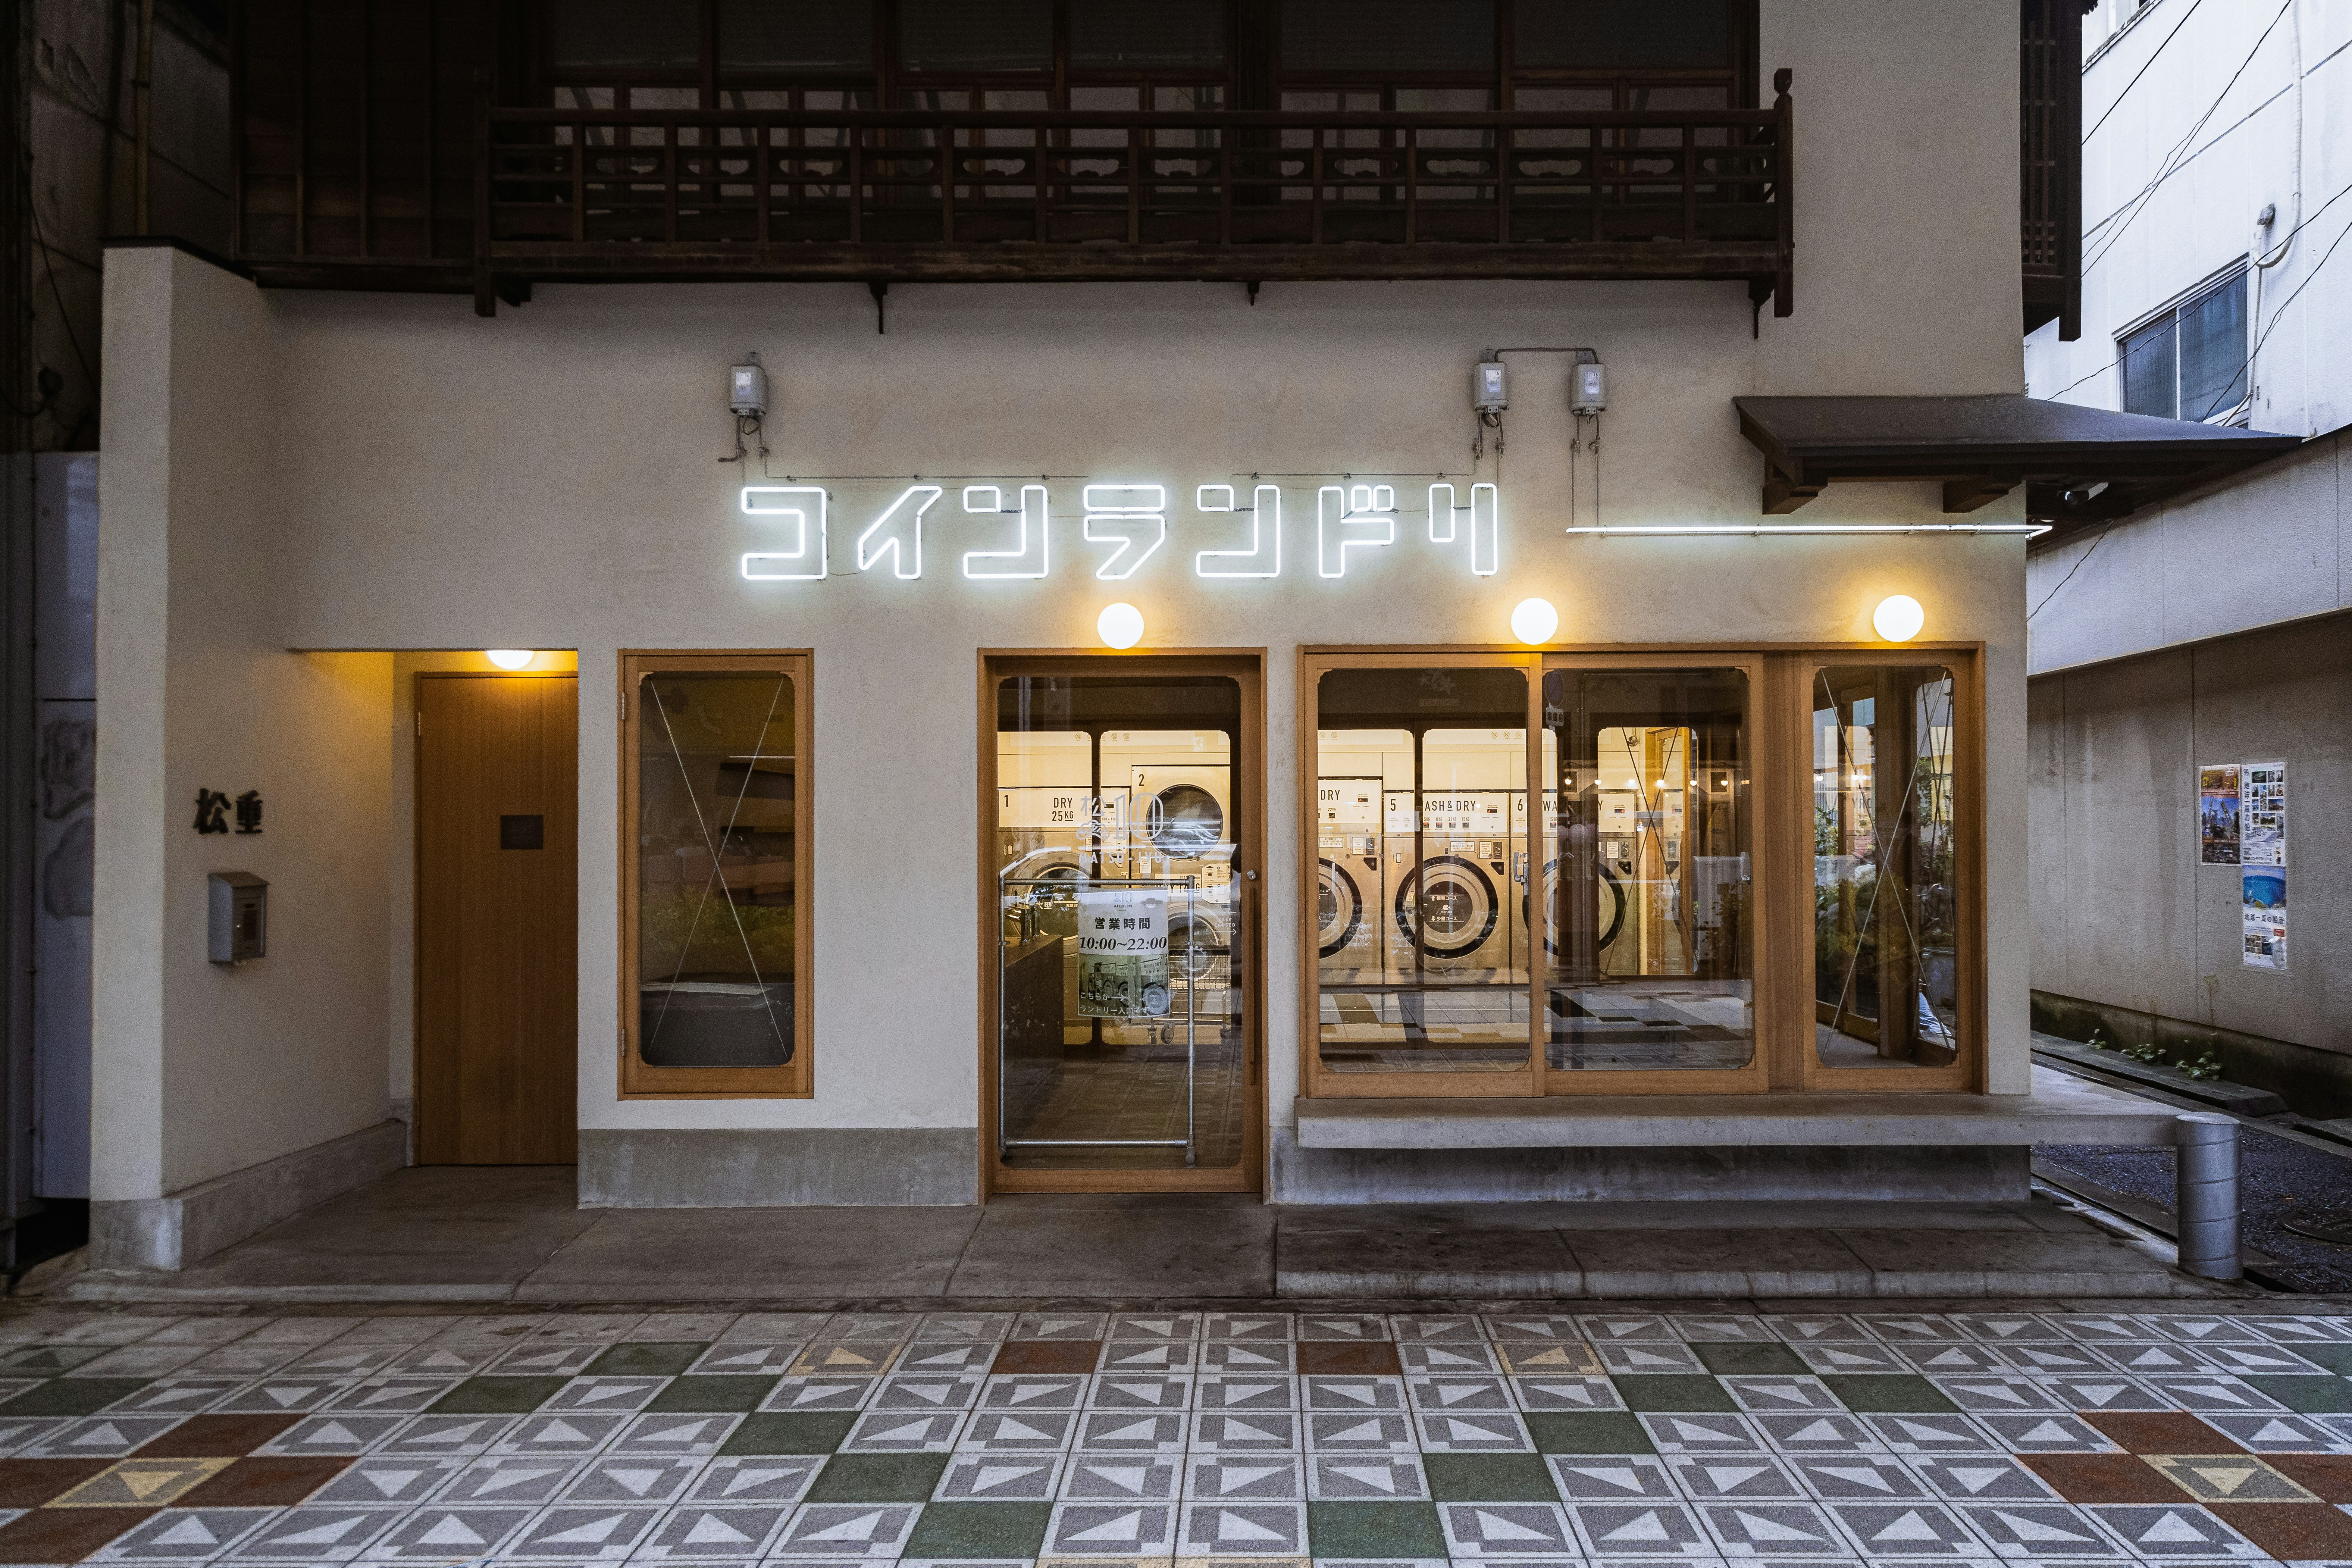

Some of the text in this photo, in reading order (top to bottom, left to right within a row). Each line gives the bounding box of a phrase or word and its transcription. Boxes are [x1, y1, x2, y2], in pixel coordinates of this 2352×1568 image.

[740, 484, 1497, 581] コインランドリ
[1139, 774, 1144, 786] 2
[1004, 795, 1008, 807] 1
[1321, 790, 1340, 800] DRY
[1053, 797, 1073, 808] DRY
[1390, 799, 1396, 811] 5
[1424, 801, 1444, 811] ASH
[1456, 801, 1476, 811] DRY
[1517, 798, 1523, 811] 6
[192, 788, 263, 835] 松重
[1052, 810, 1074, 821] 25KG
[1094, 917, 1150, 930] 営業時間
